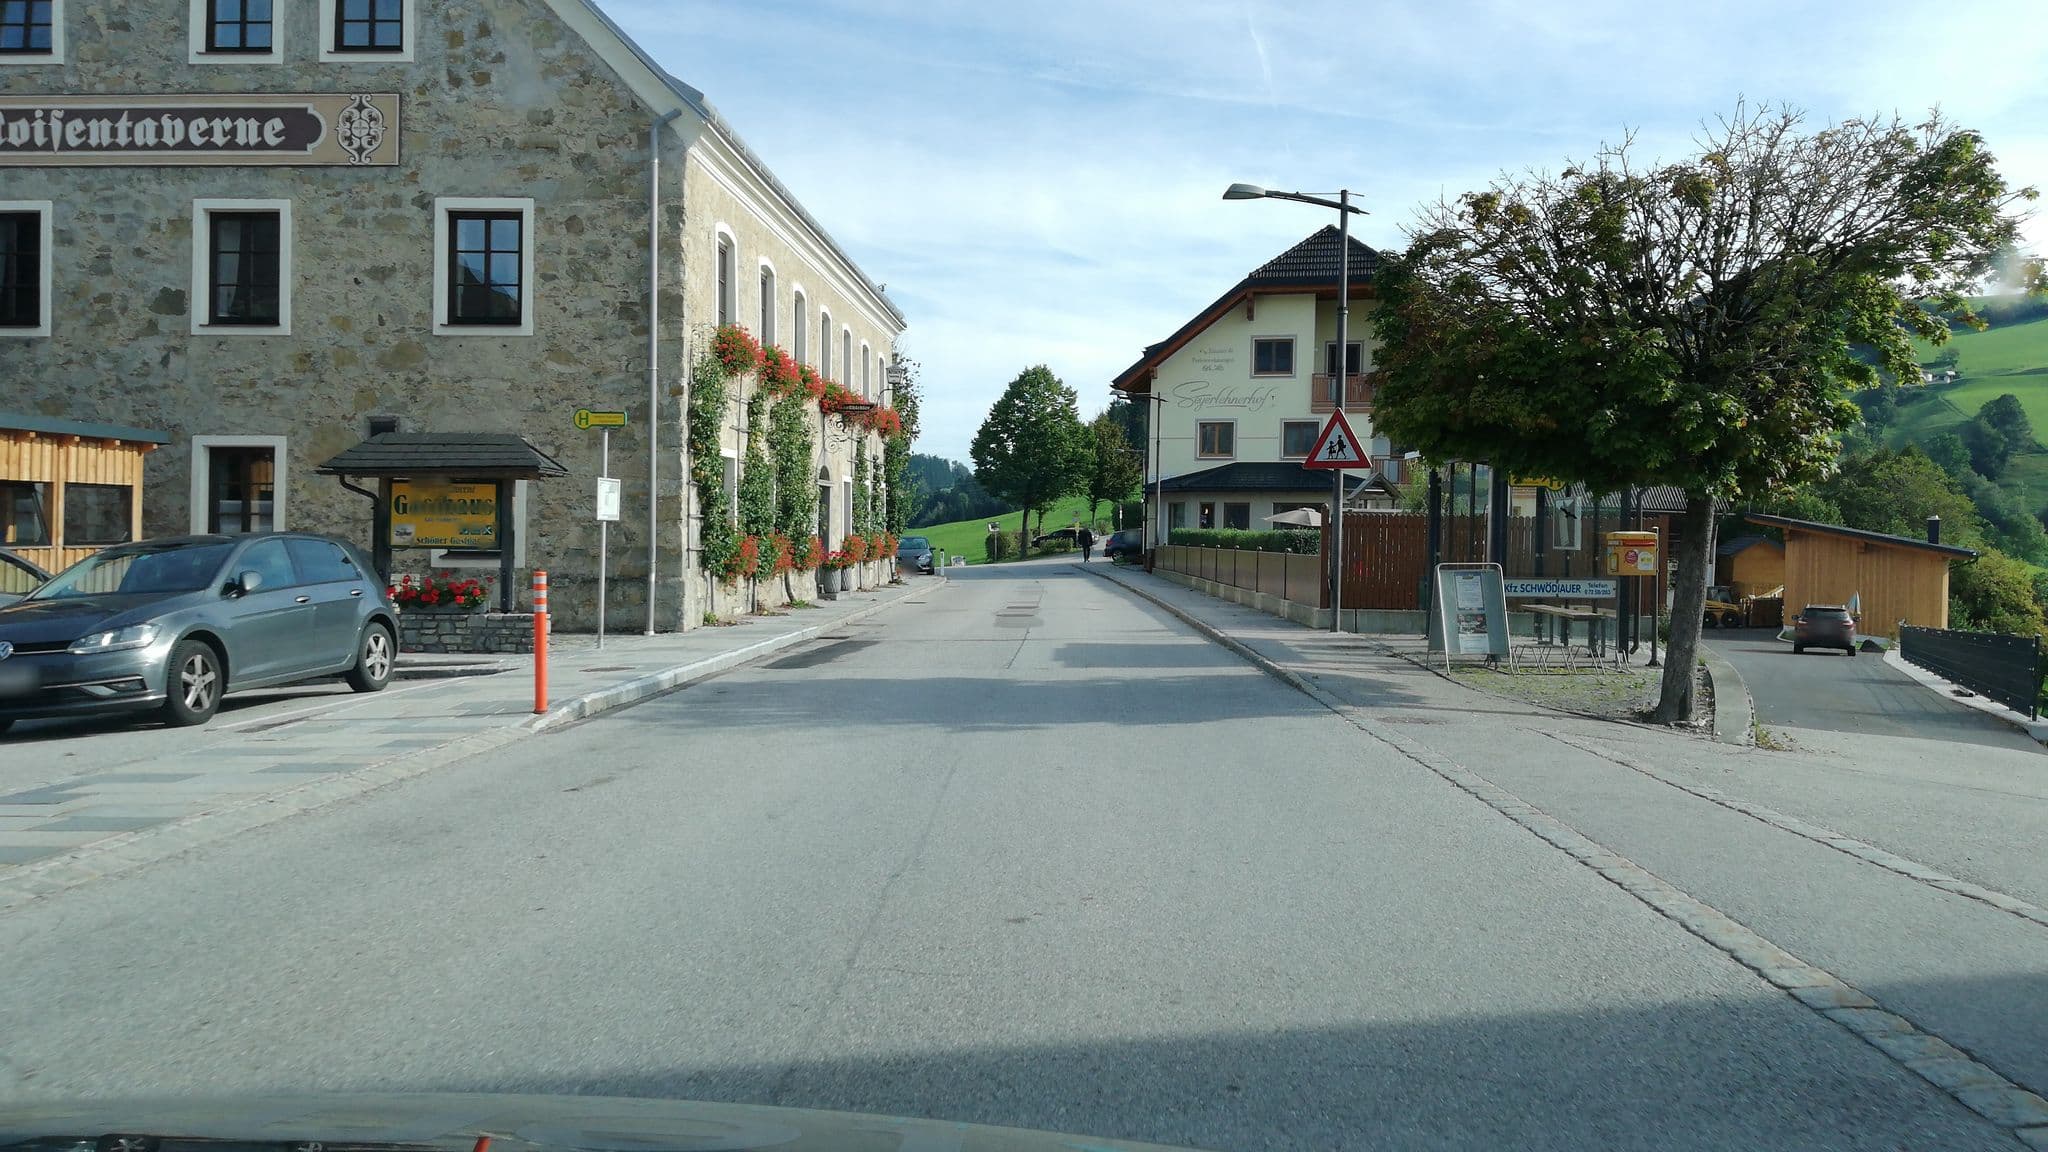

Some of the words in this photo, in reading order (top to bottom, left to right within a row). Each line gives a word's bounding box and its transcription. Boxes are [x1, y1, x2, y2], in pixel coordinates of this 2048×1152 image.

[578, 412, 589, 426] H
[1504, 583, 1518, 593] Kfz
[1519, 581, 1582, 594] SCHWÖDIAUER
